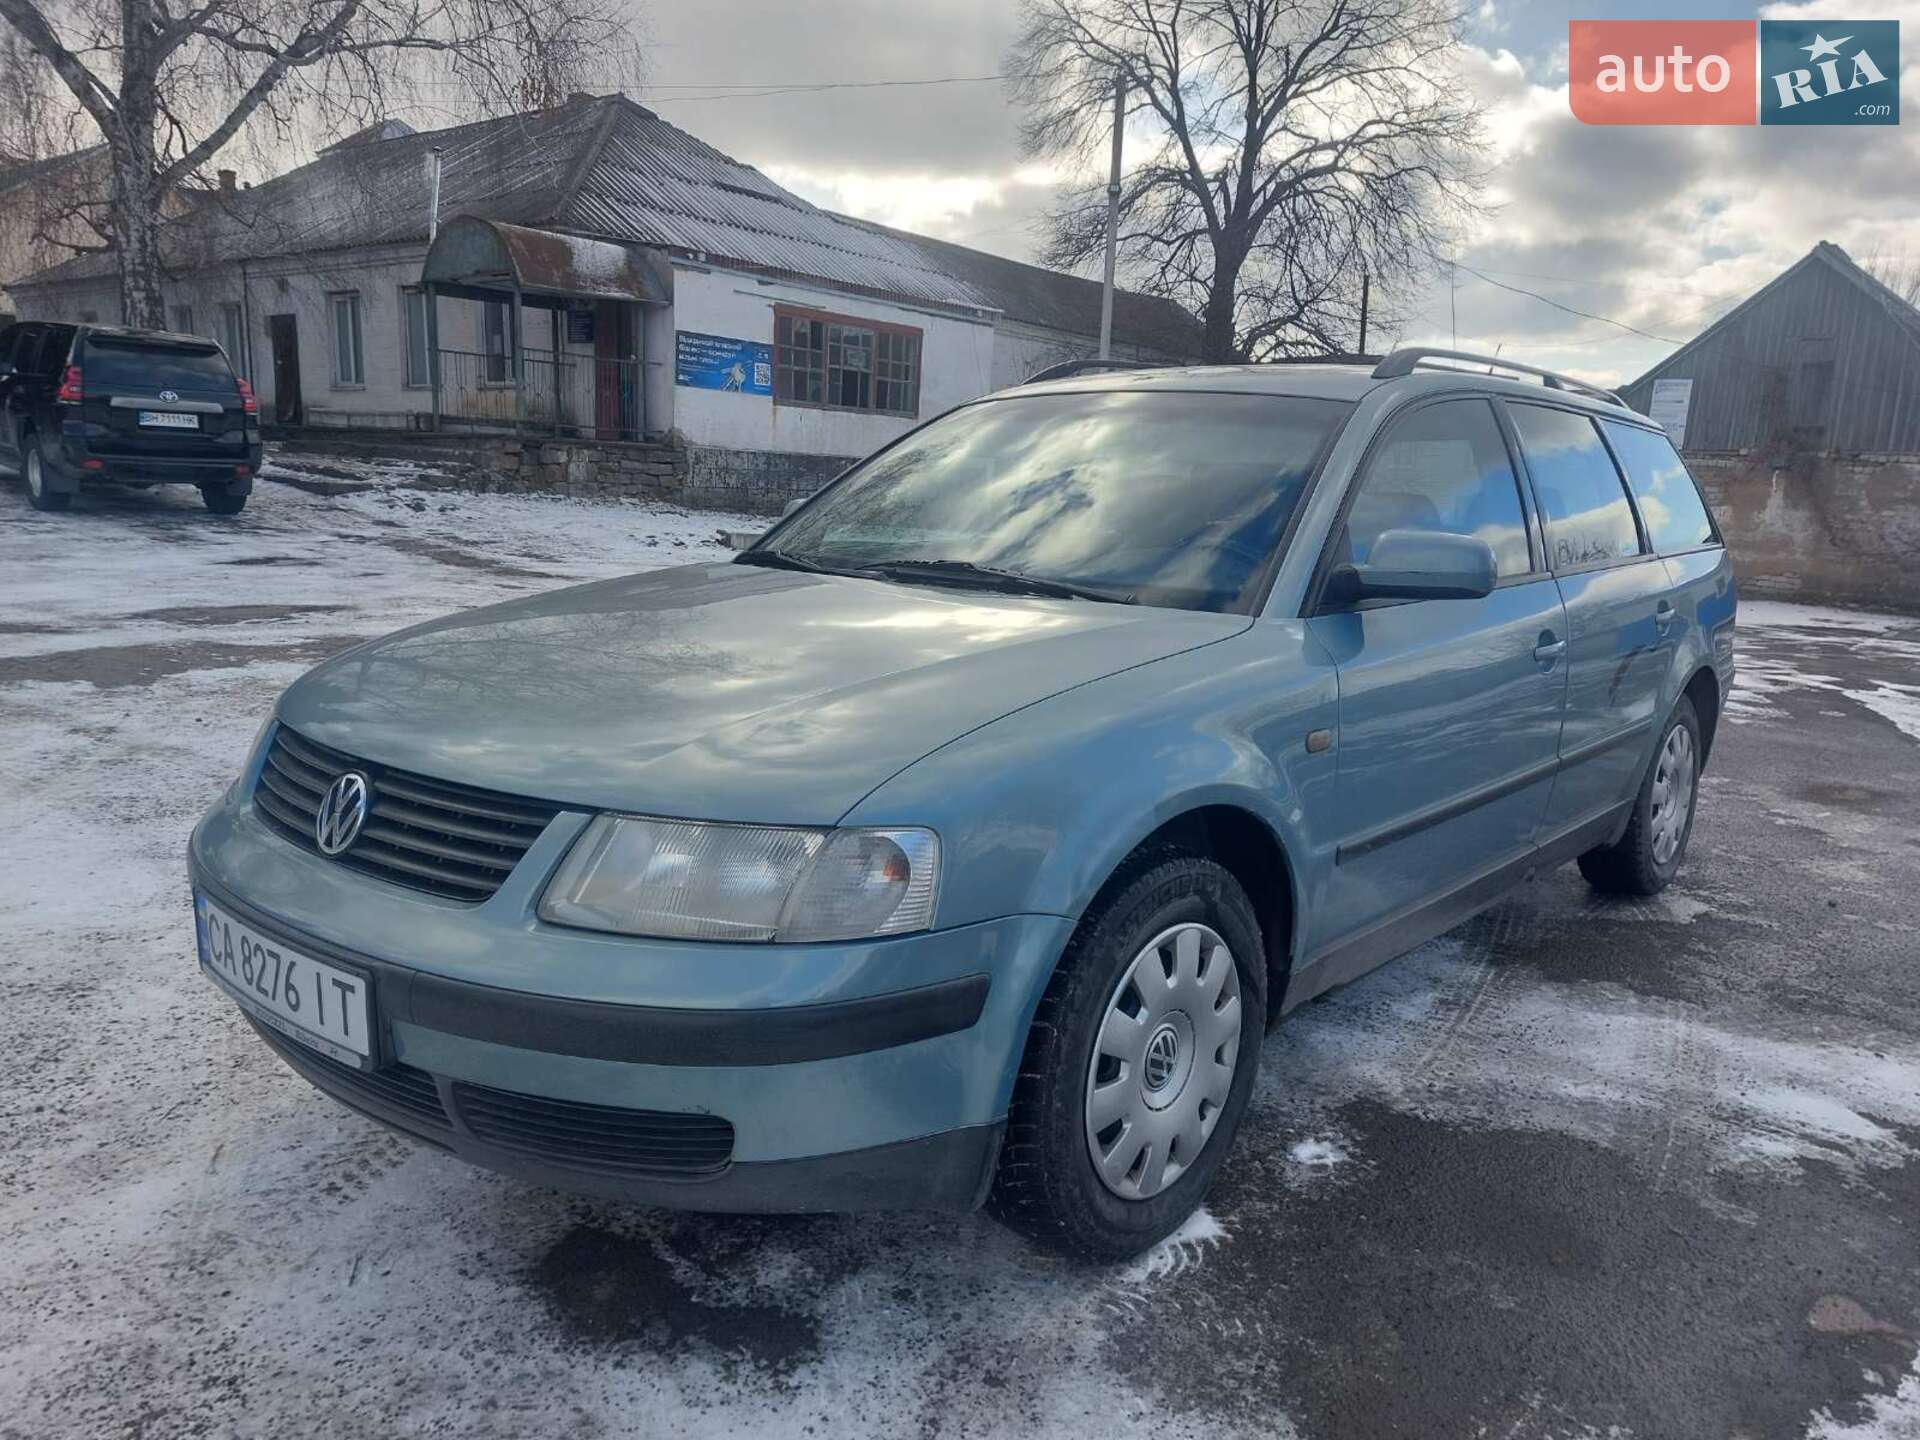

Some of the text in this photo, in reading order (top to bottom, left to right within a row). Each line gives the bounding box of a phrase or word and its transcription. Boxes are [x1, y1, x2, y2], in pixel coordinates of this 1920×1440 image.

[208, 913, 237, 976] CA
[241, 935, 300, 1013] 8276
[316, 971, 356, 1037] IT
